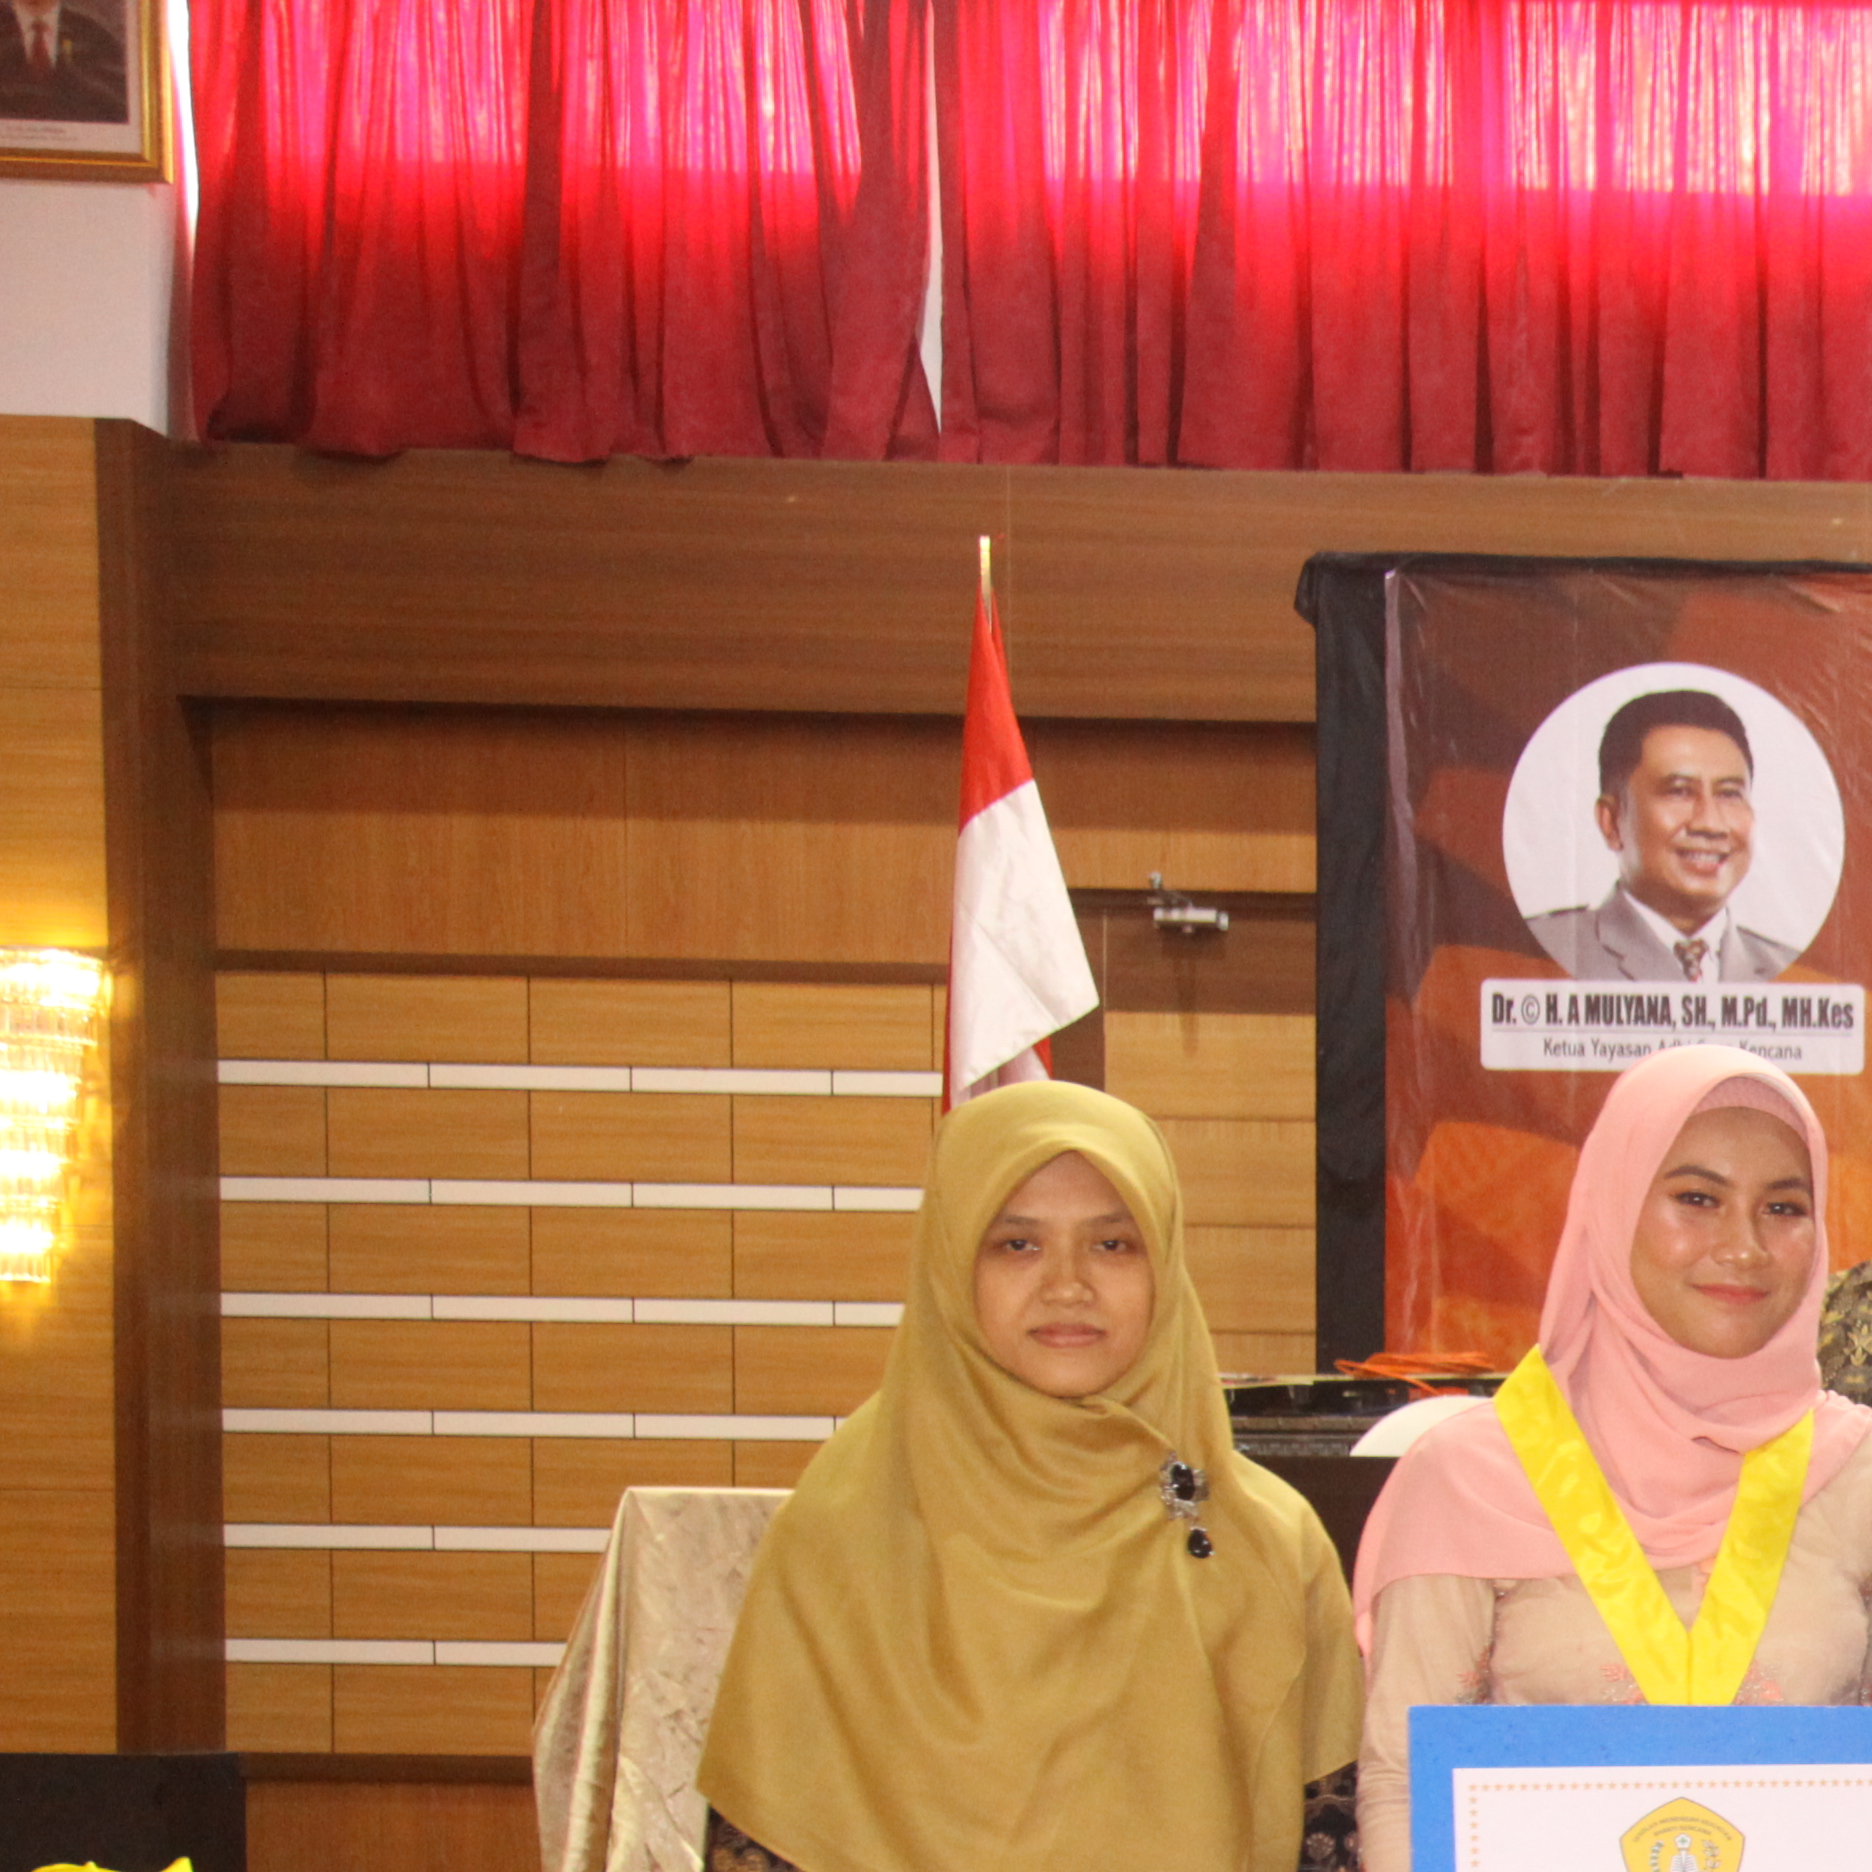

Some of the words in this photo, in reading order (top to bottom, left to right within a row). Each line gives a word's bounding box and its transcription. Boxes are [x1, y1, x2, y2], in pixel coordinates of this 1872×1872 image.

[1491, 992, 1518, 1025] Dr.
[1545, 993, 1564, 1026] H.
[1566, 994, 1581, 1026] A
[1584, 994, 1677, 1030] MULYANA,
[1781, 997, 1855, 1030] MH.Kes
[1542, 1037, 1586, 1057] Ketua
[1590, 1038, 1653, 1063] Yayasan
